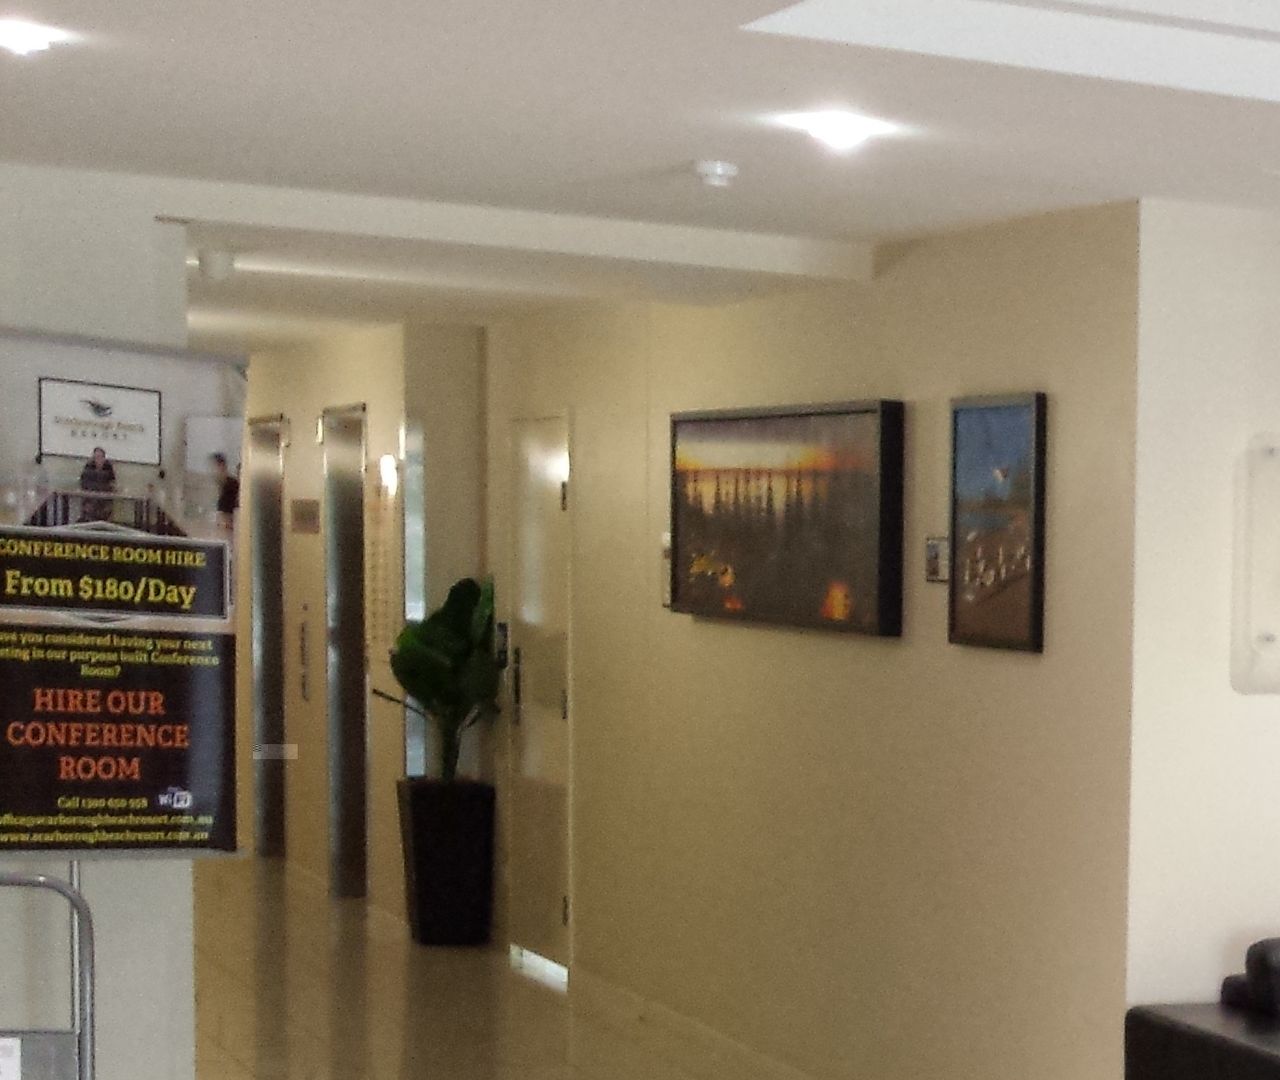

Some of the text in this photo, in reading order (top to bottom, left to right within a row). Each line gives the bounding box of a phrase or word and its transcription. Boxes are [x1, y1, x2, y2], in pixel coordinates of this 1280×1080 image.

[112, 546, 163, 564] ROOM
[165, 551, 206, 567] HIRE
[5, 569, 197, 610] From $180/Day
[33, 688, 166, 715] HIRE OUR
[6, 720, 190, 749] CONFERENCE
[58, 755, 141, 780] ROOM
